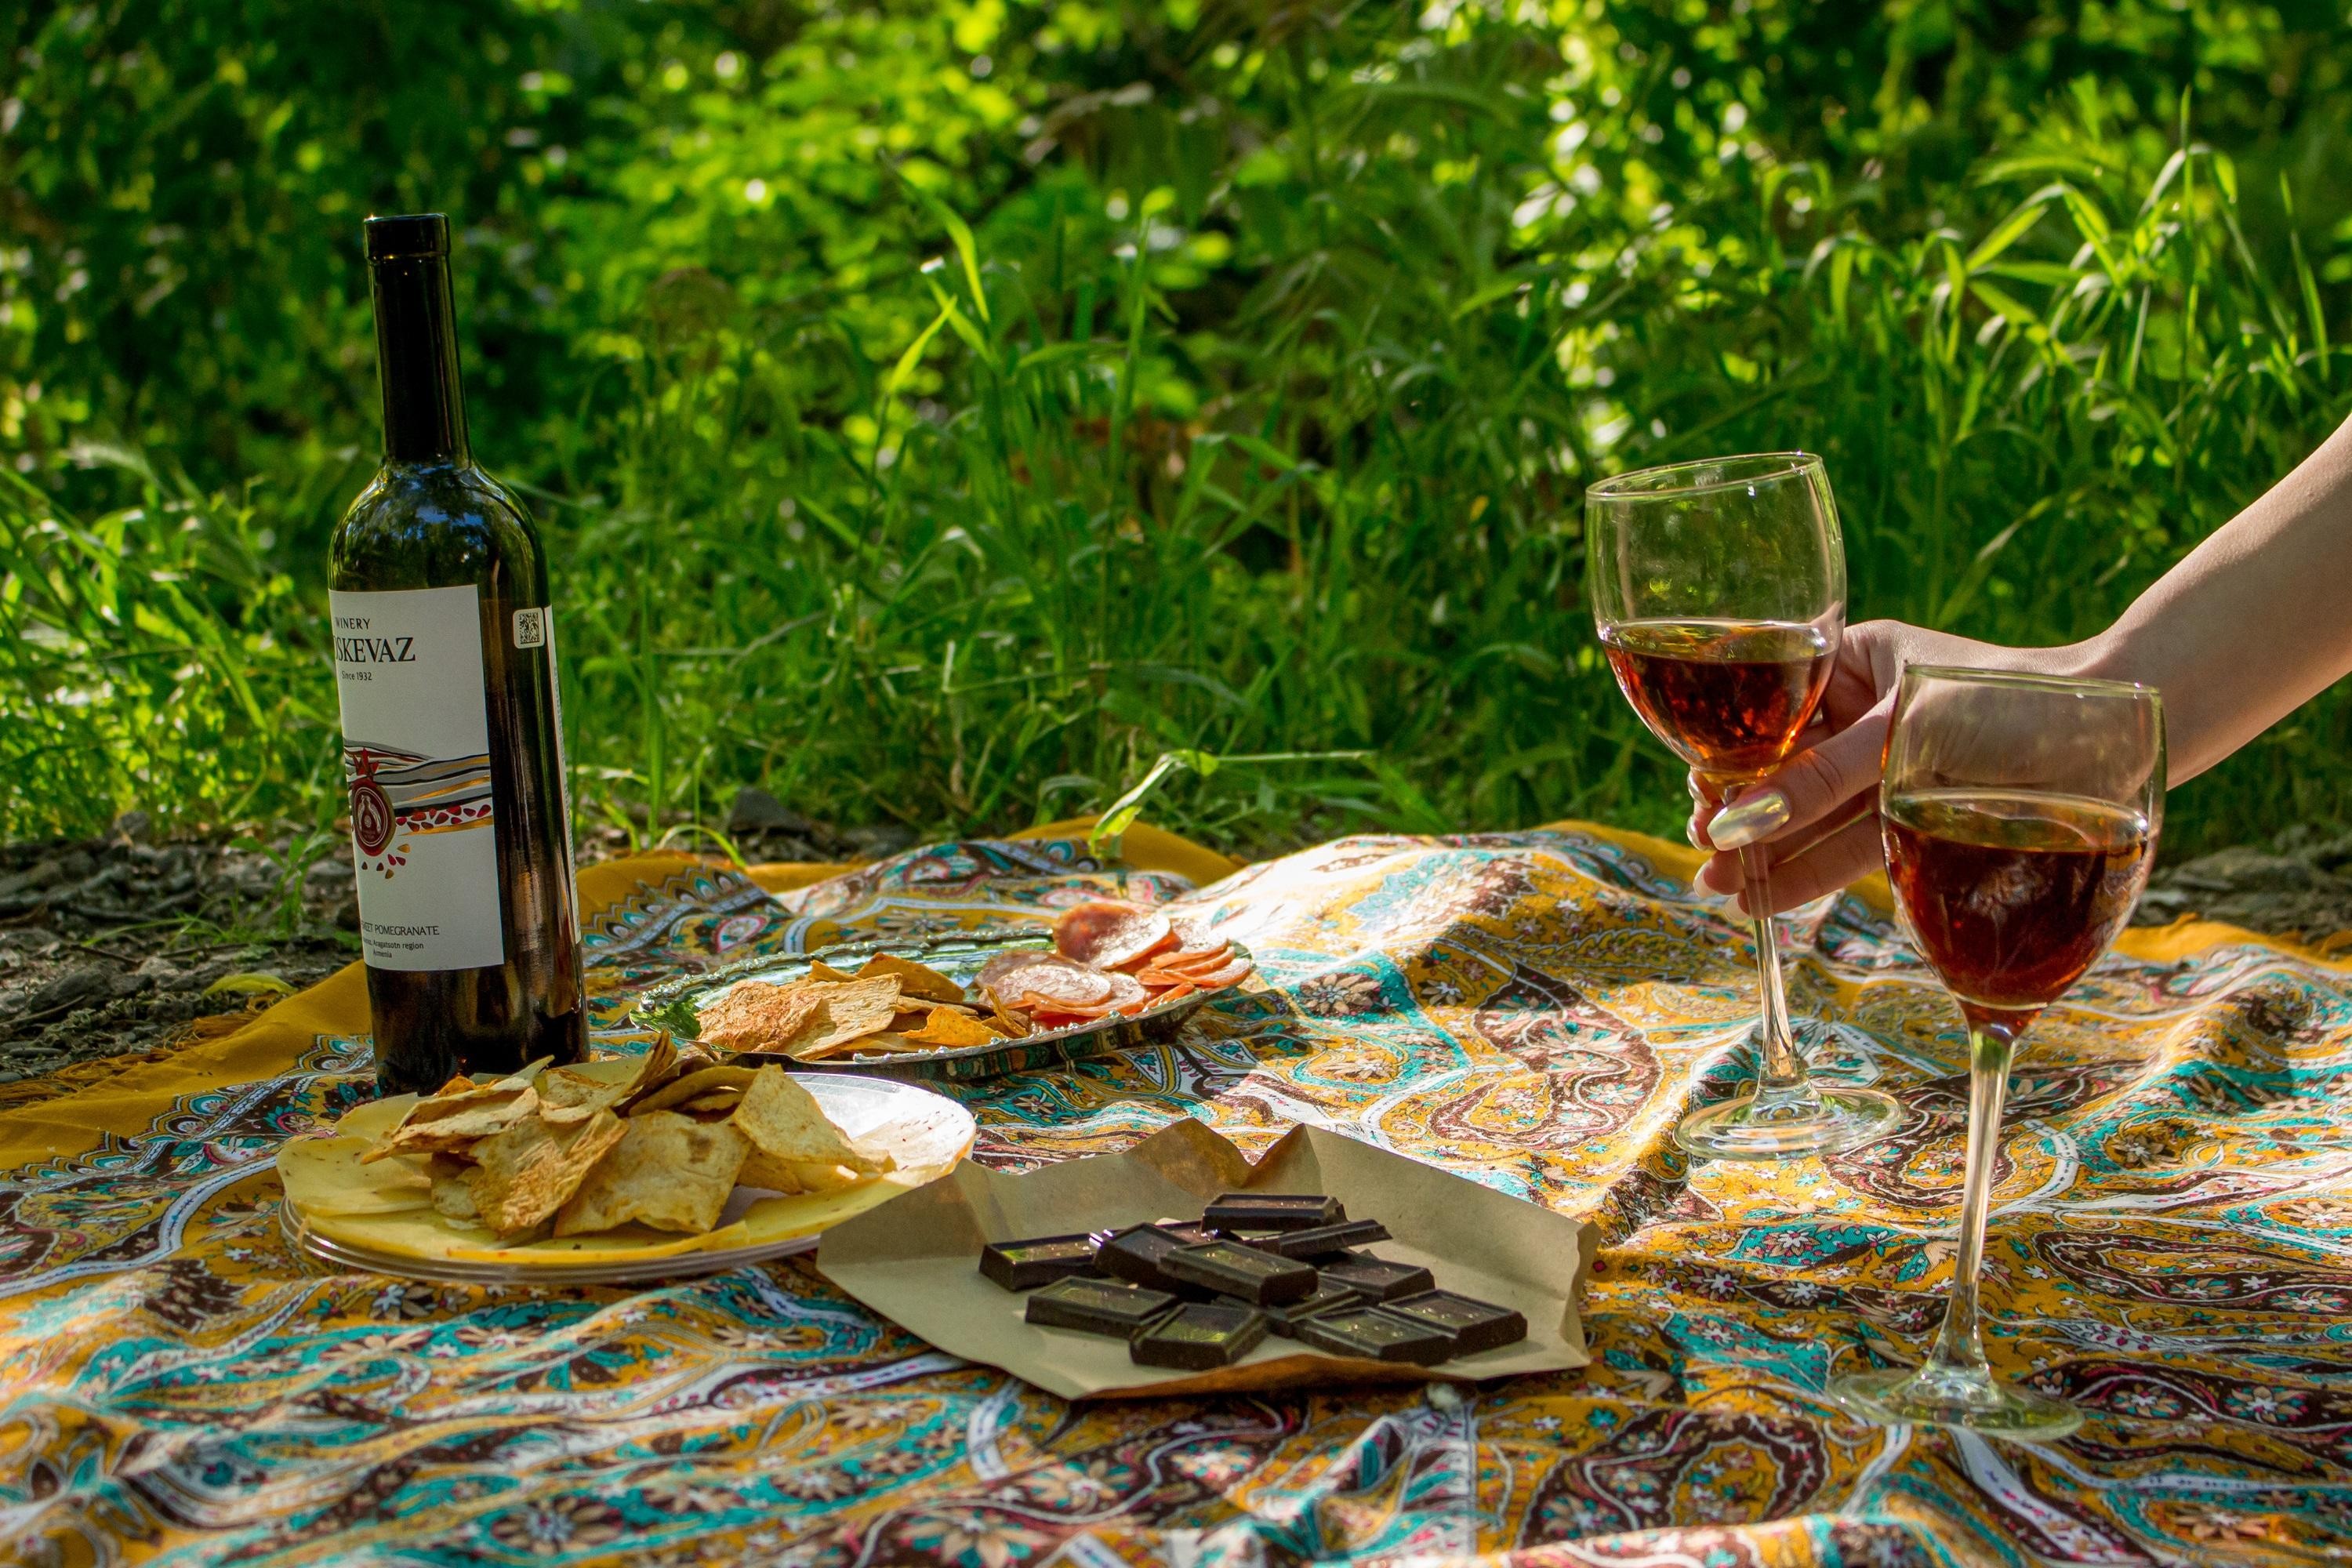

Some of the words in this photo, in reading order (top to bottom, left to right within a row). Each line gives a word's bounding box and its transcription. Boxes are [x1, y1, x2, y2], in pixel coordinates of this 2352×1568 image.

[336, 616, 371, 630] WINERY
[342, 671, 355, 681] Since
[356, 672, 372, 681] 1932
[374, 924, 440, 936] POMEGRANATE
[402, 942, 424, 950] region
